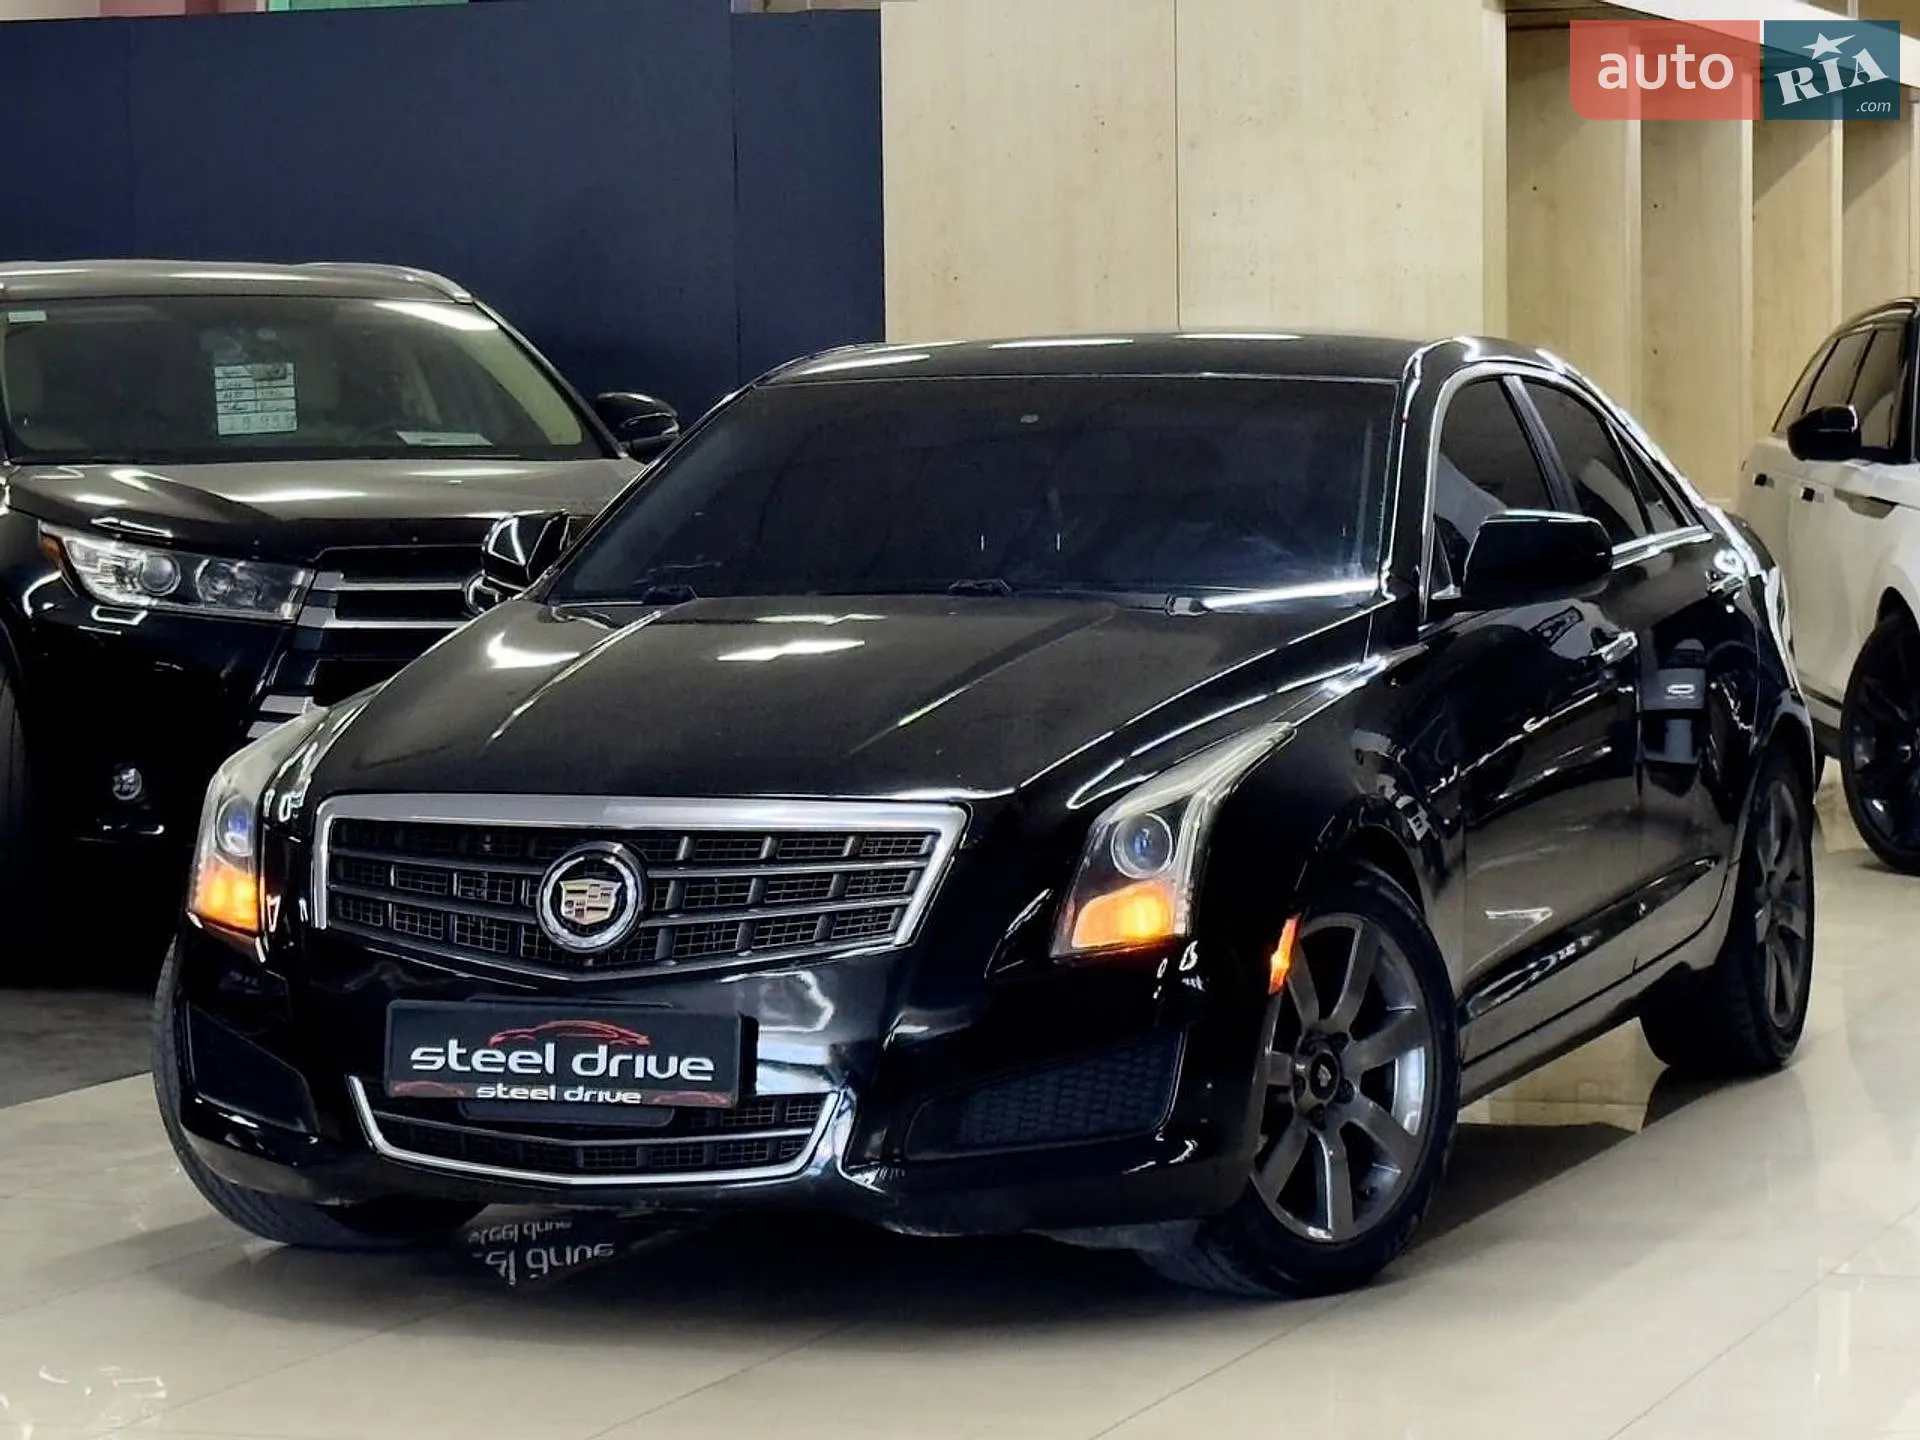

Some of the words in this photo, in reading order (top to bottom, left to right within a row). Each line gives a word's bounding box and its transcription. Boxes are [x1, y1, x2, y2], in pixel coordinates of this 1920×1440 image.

[410, 1040, 556, 1074] steel
[571, 1045, 715, 1081] drive
[476, 1082, 556, 1100] steel
[563, 1085, 642, 1104] drive
